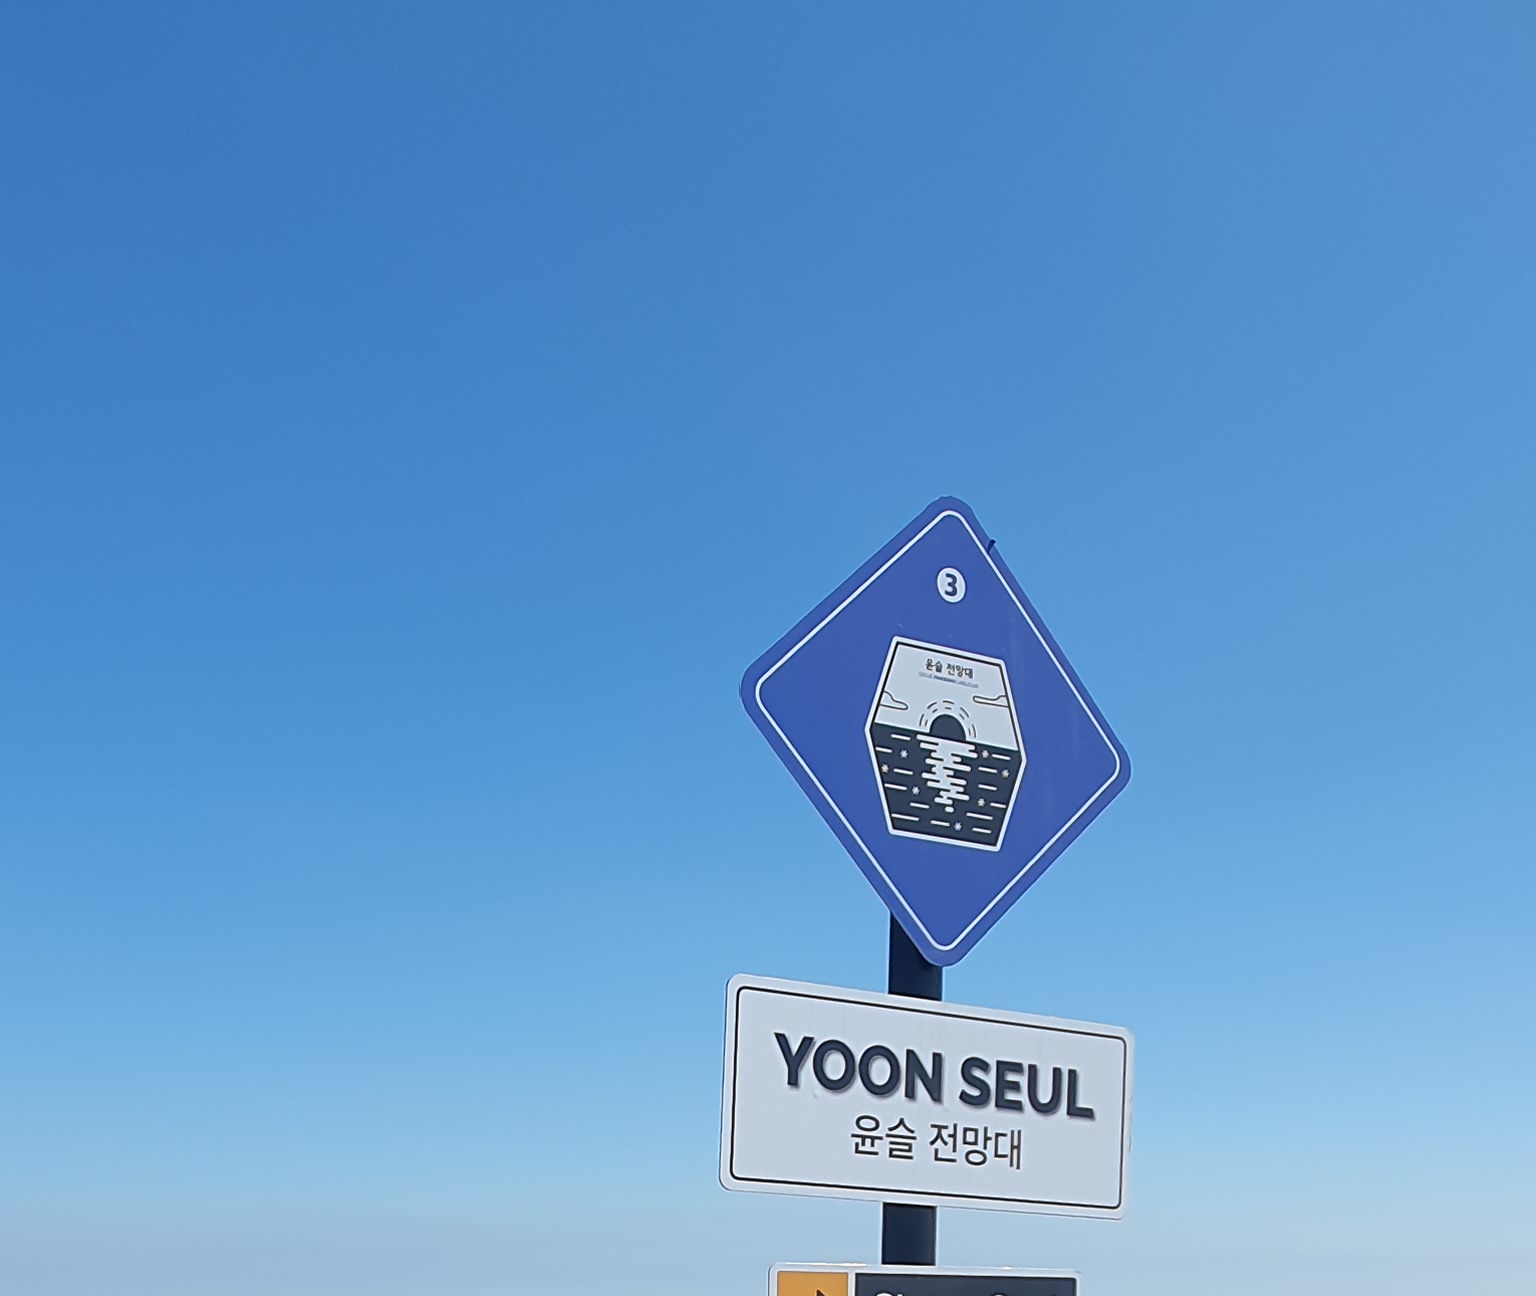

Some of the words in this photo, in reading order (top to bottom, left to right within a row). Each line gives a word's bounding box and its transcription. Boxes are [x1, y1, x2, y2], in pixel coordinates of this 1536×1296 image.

[774, 1032, 943, 1103] YOON
[958, 1056, 1096, 1121] SEUL
[850, 1115, 917, 1160] 윤슬
[929, 1122, 1023, 1170] 전망대
